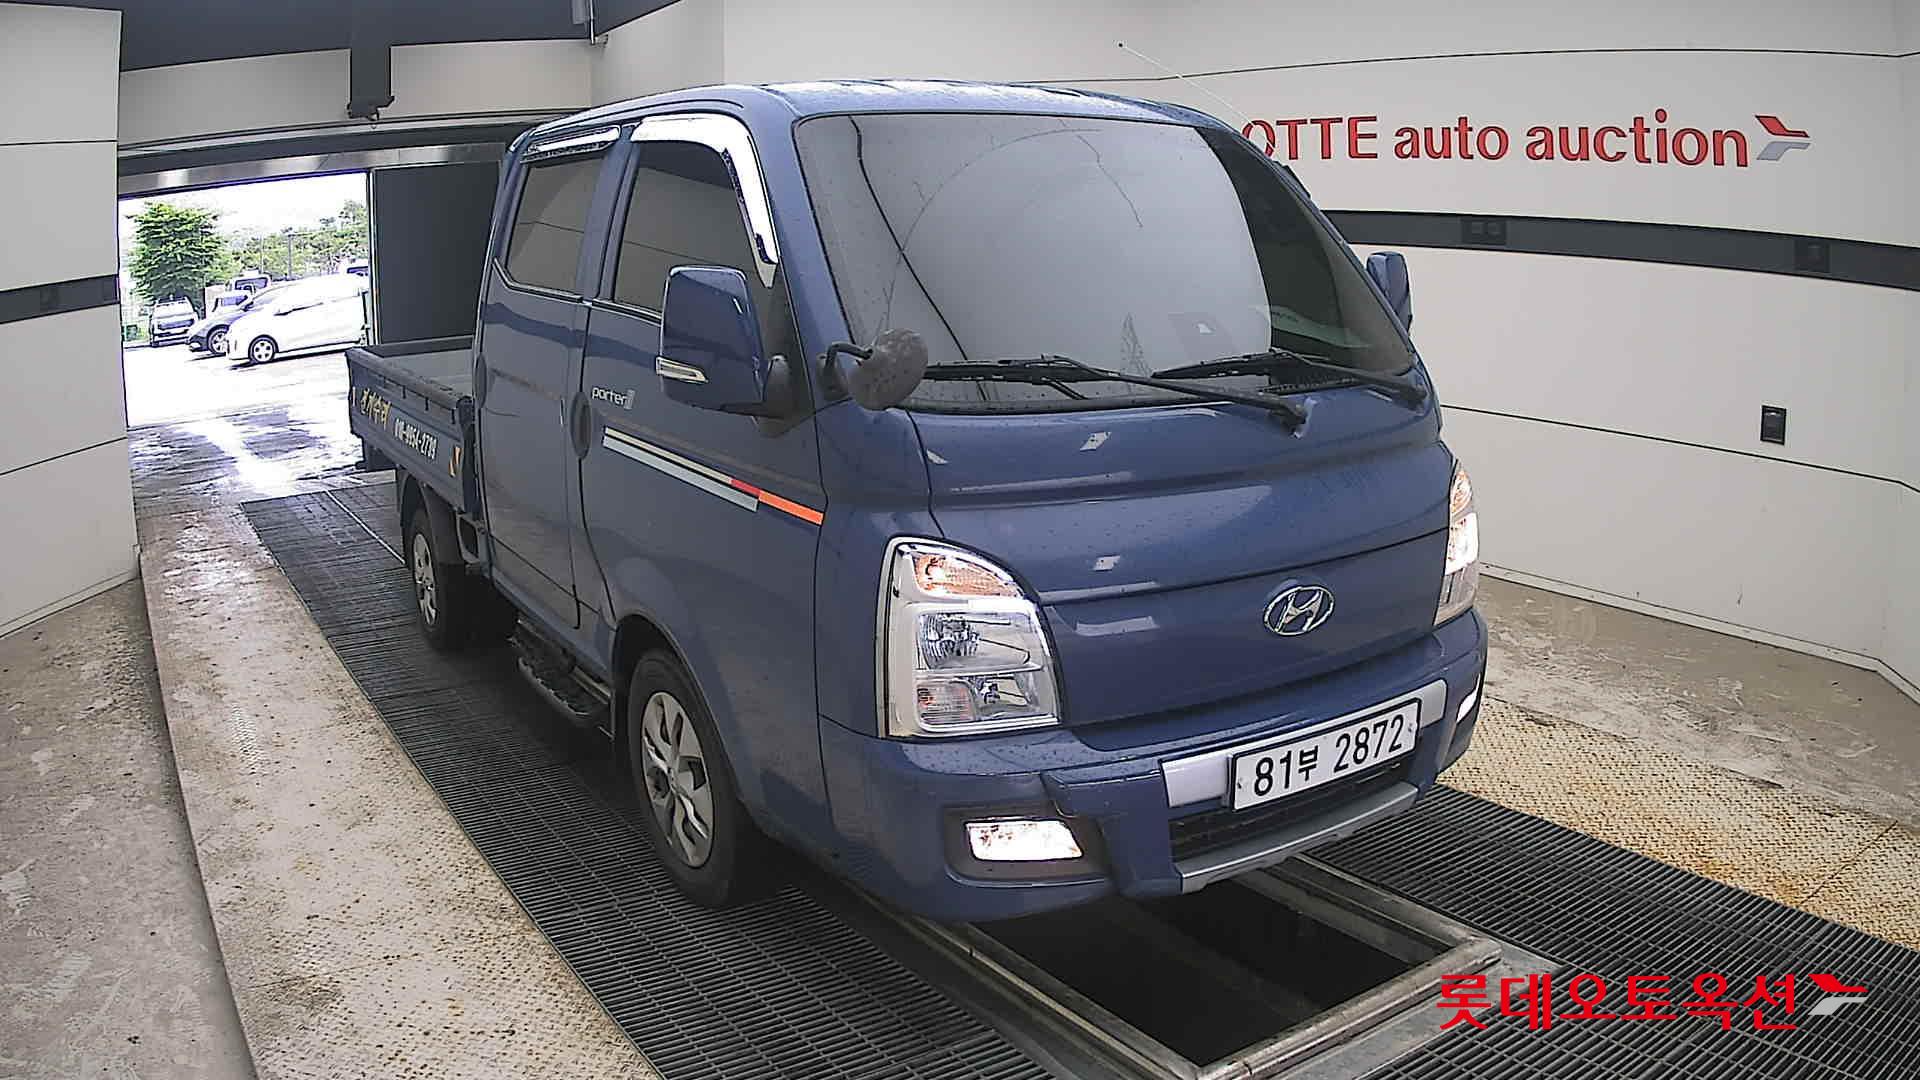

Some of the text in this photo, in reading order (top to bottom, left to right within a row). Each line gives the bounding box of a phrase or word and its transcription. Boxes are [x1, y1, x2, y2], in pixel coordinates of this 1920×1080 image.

[1242, 108, 1749, 168] OTTE auto auction
[1254, 714, 1404, 796] 81부 2872
